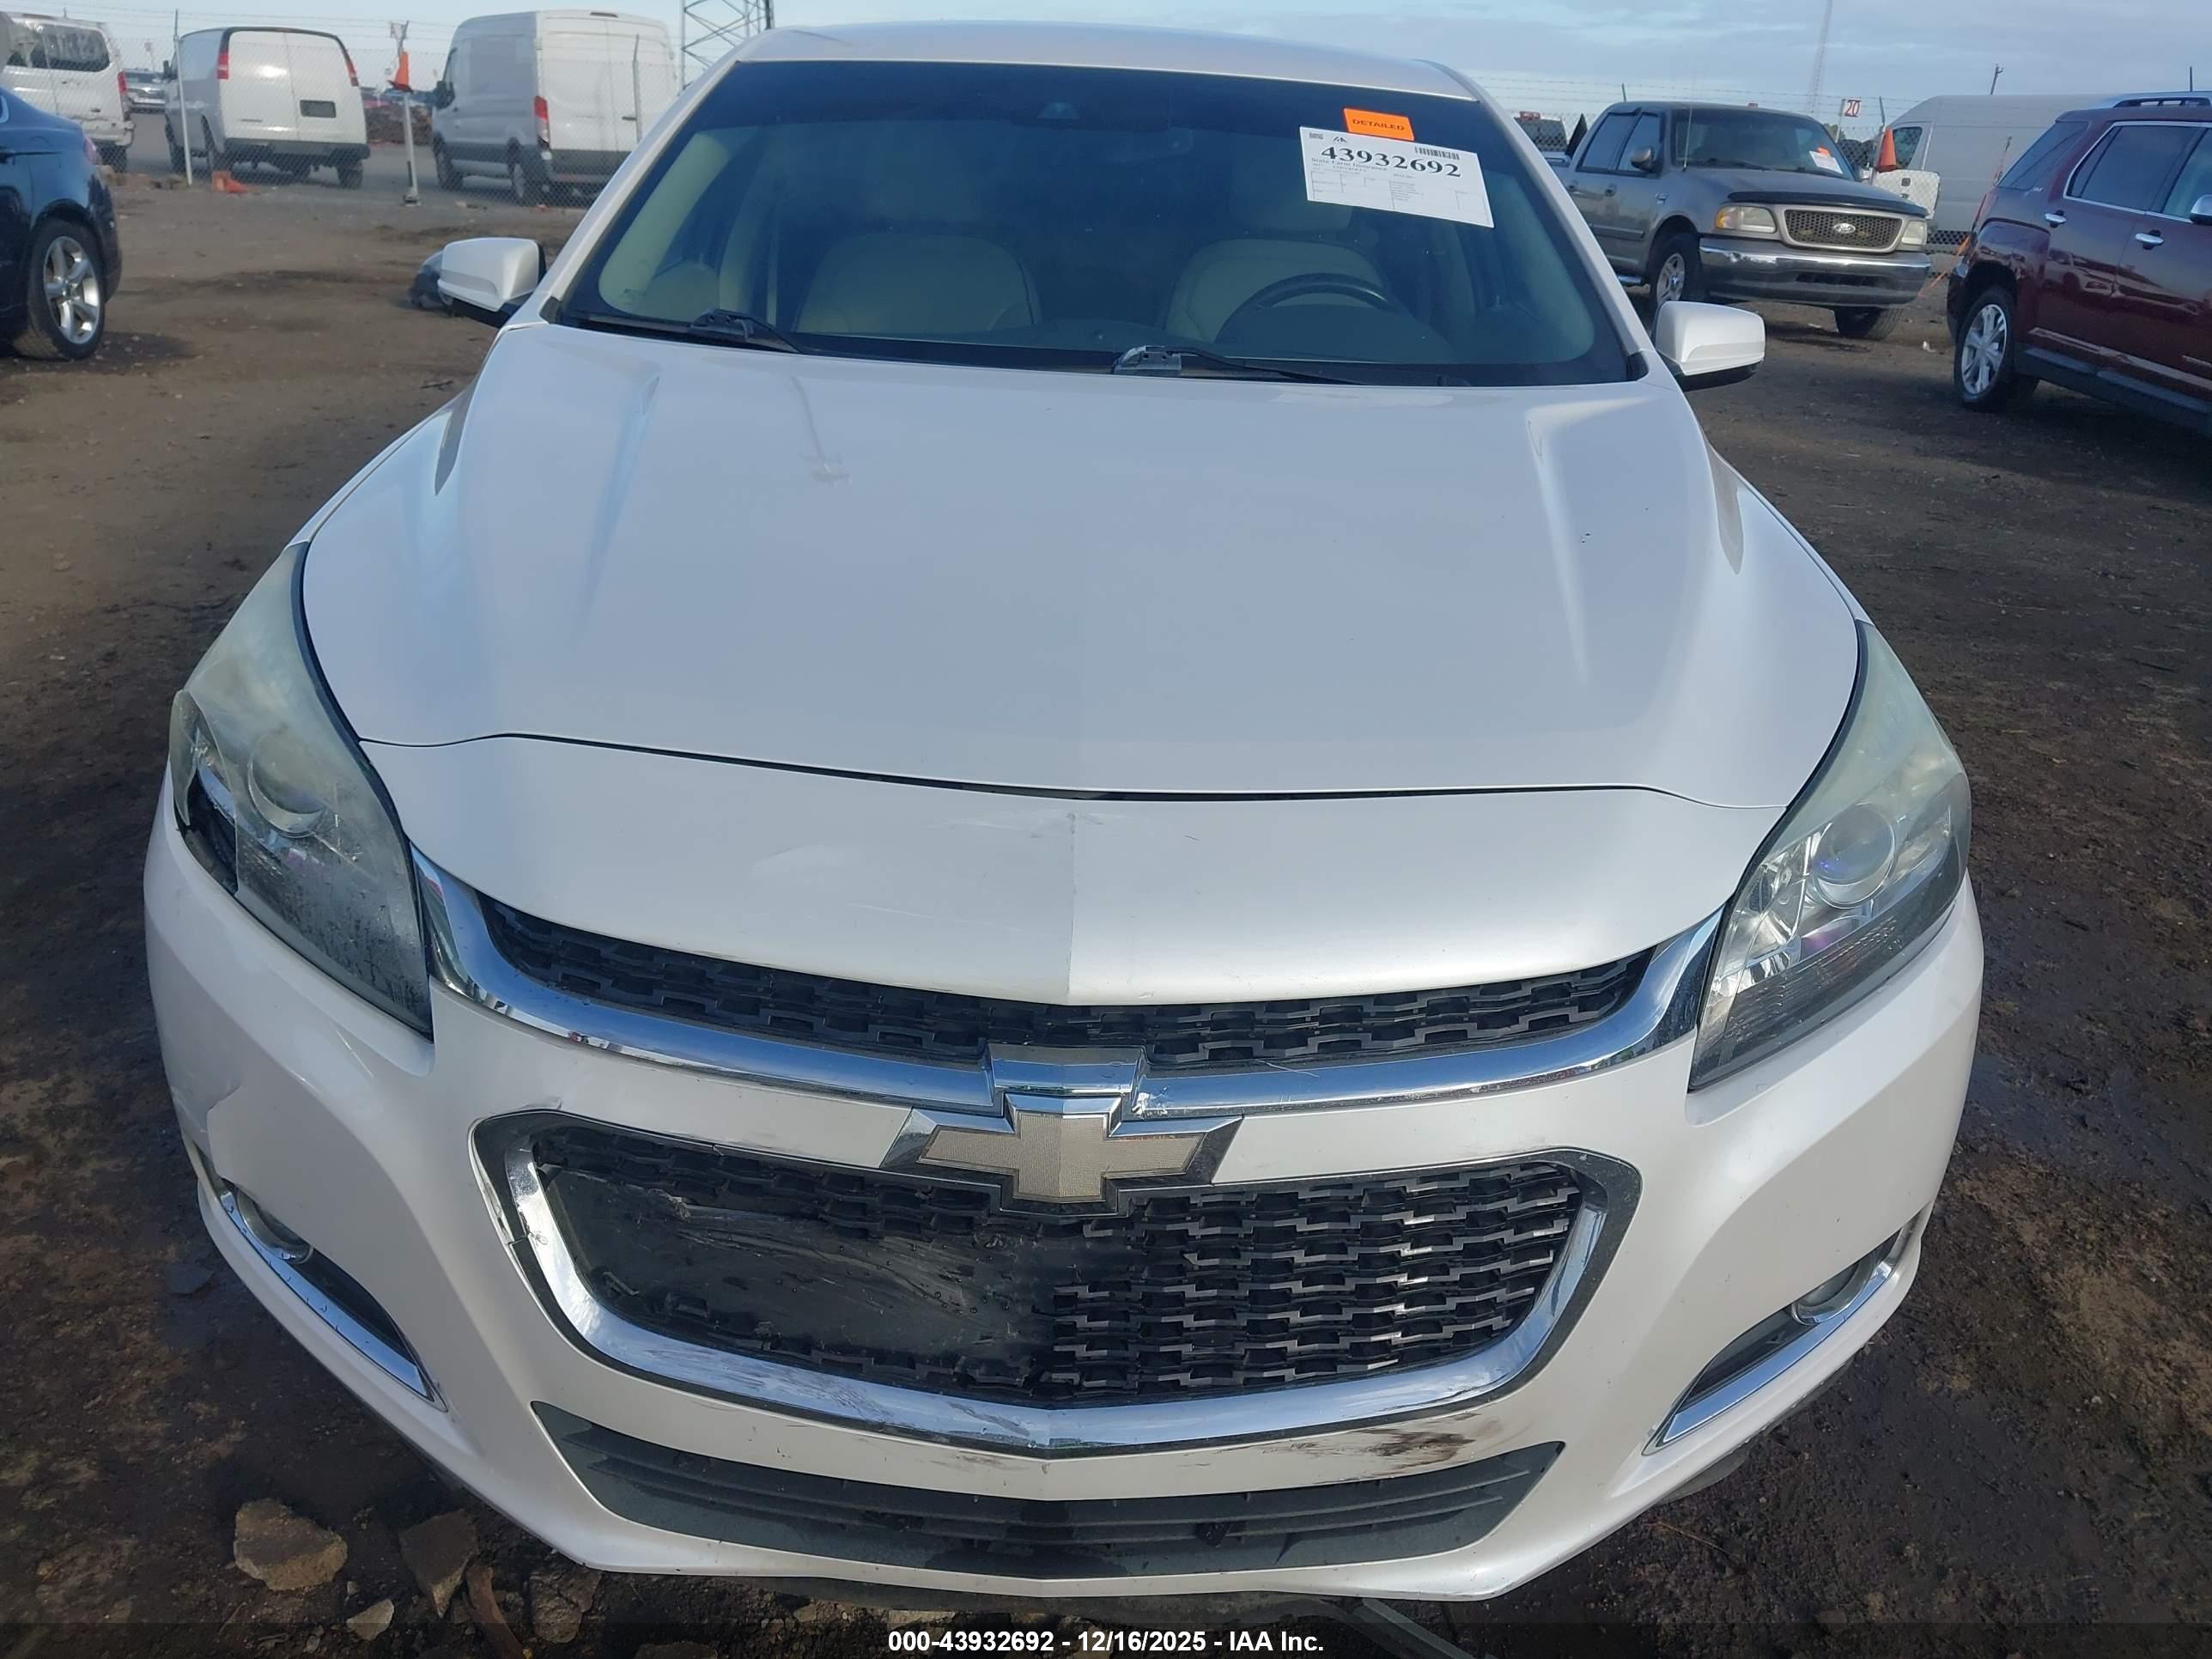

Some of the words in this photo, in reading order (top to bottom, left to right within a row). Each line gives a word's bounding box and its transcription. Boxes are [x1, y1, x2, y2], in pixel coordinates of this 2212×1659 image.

[1844, 99, 1862, 118] 20
[1352, 118, 1405, 131] DETAILED
[1321, 146, 1461, 178] 43932692
